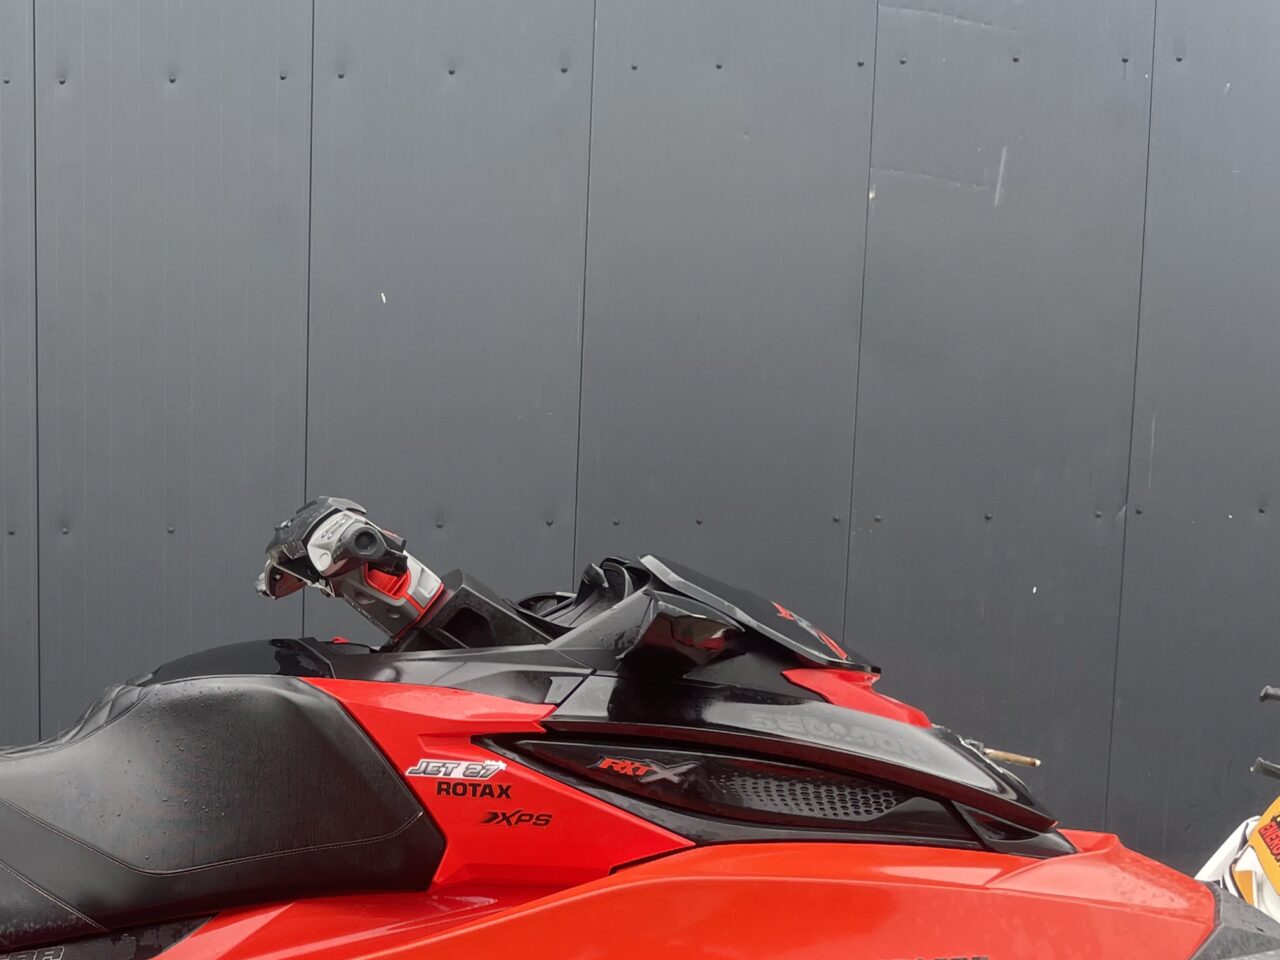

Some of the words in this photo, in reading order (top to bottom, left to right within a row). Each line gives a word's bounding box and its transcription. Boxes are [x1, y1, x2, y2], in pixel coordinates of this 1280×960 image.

[407, 759, 460, 777] JET
[462, 762, 501, 779] 27
[435, 780, 512, 799] ROTAX
